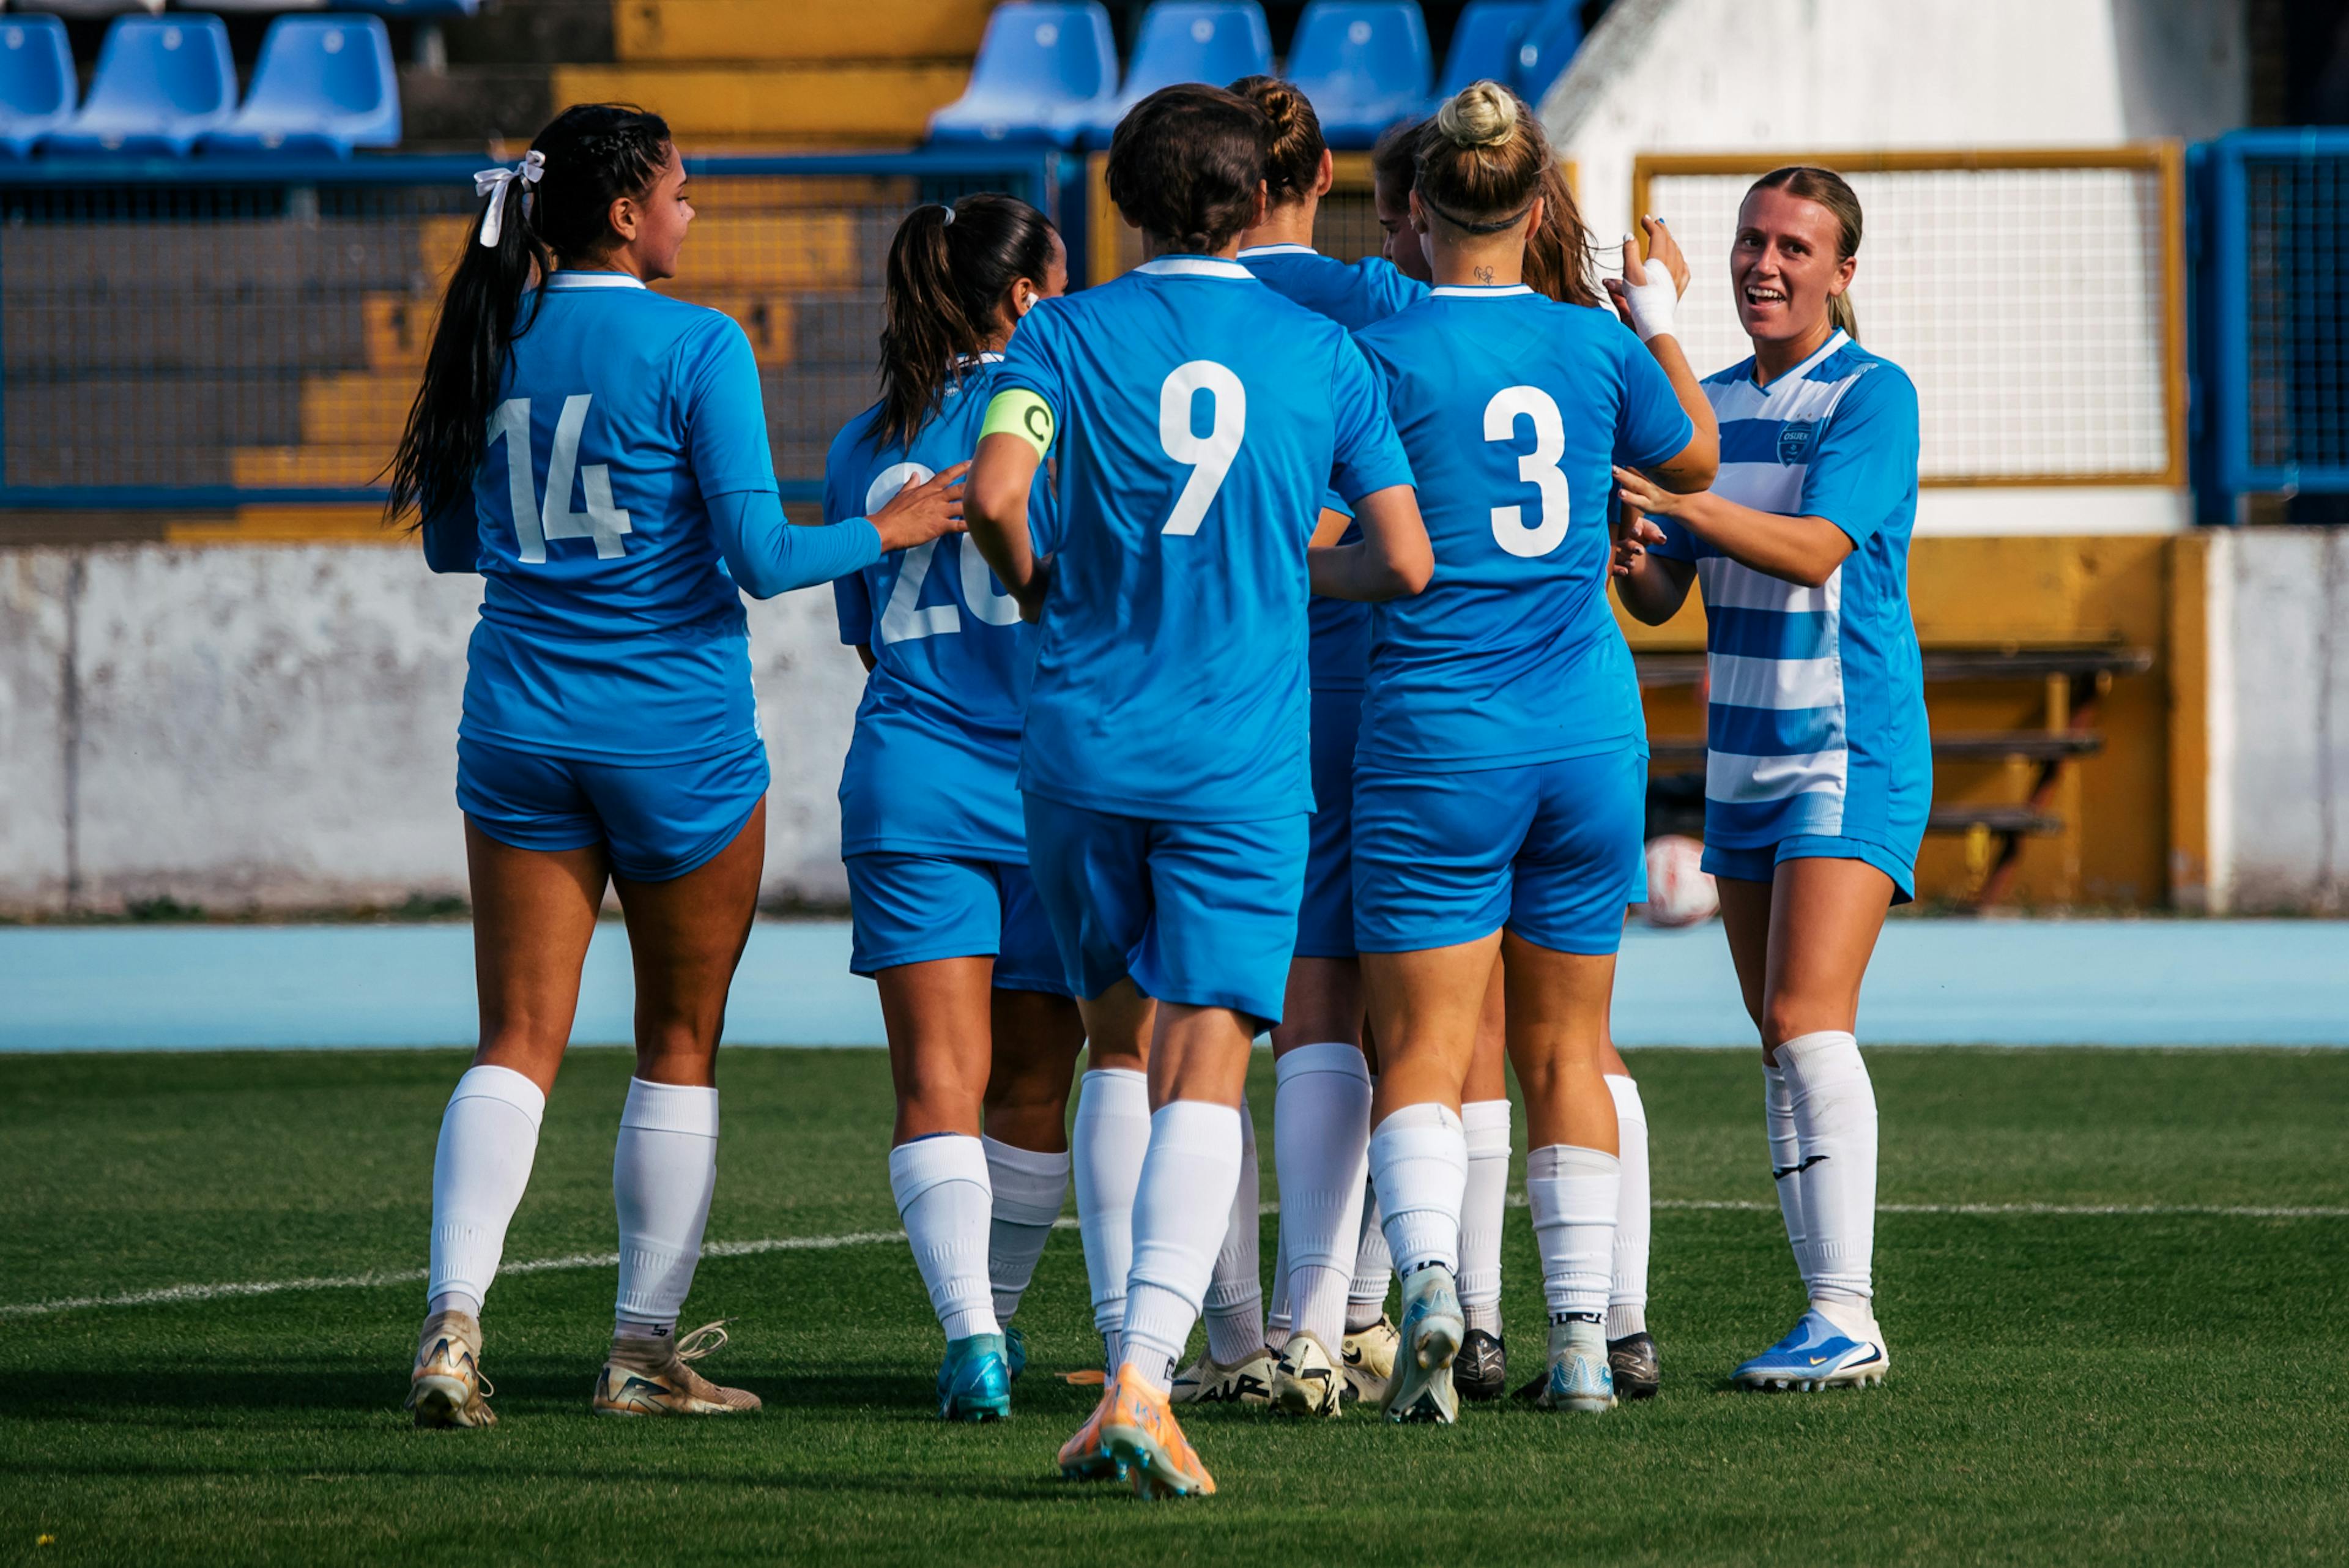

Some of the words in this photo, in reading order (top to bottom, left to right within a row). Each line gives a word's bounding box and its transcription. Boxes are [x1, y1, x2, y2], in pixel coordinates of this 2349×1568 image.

[487, 393, 632, 564] 14
[1025, 405, 1050, 442] C
[1159, 360, 1245, 536] 9
[1483, 385, 1570, 557] 3
